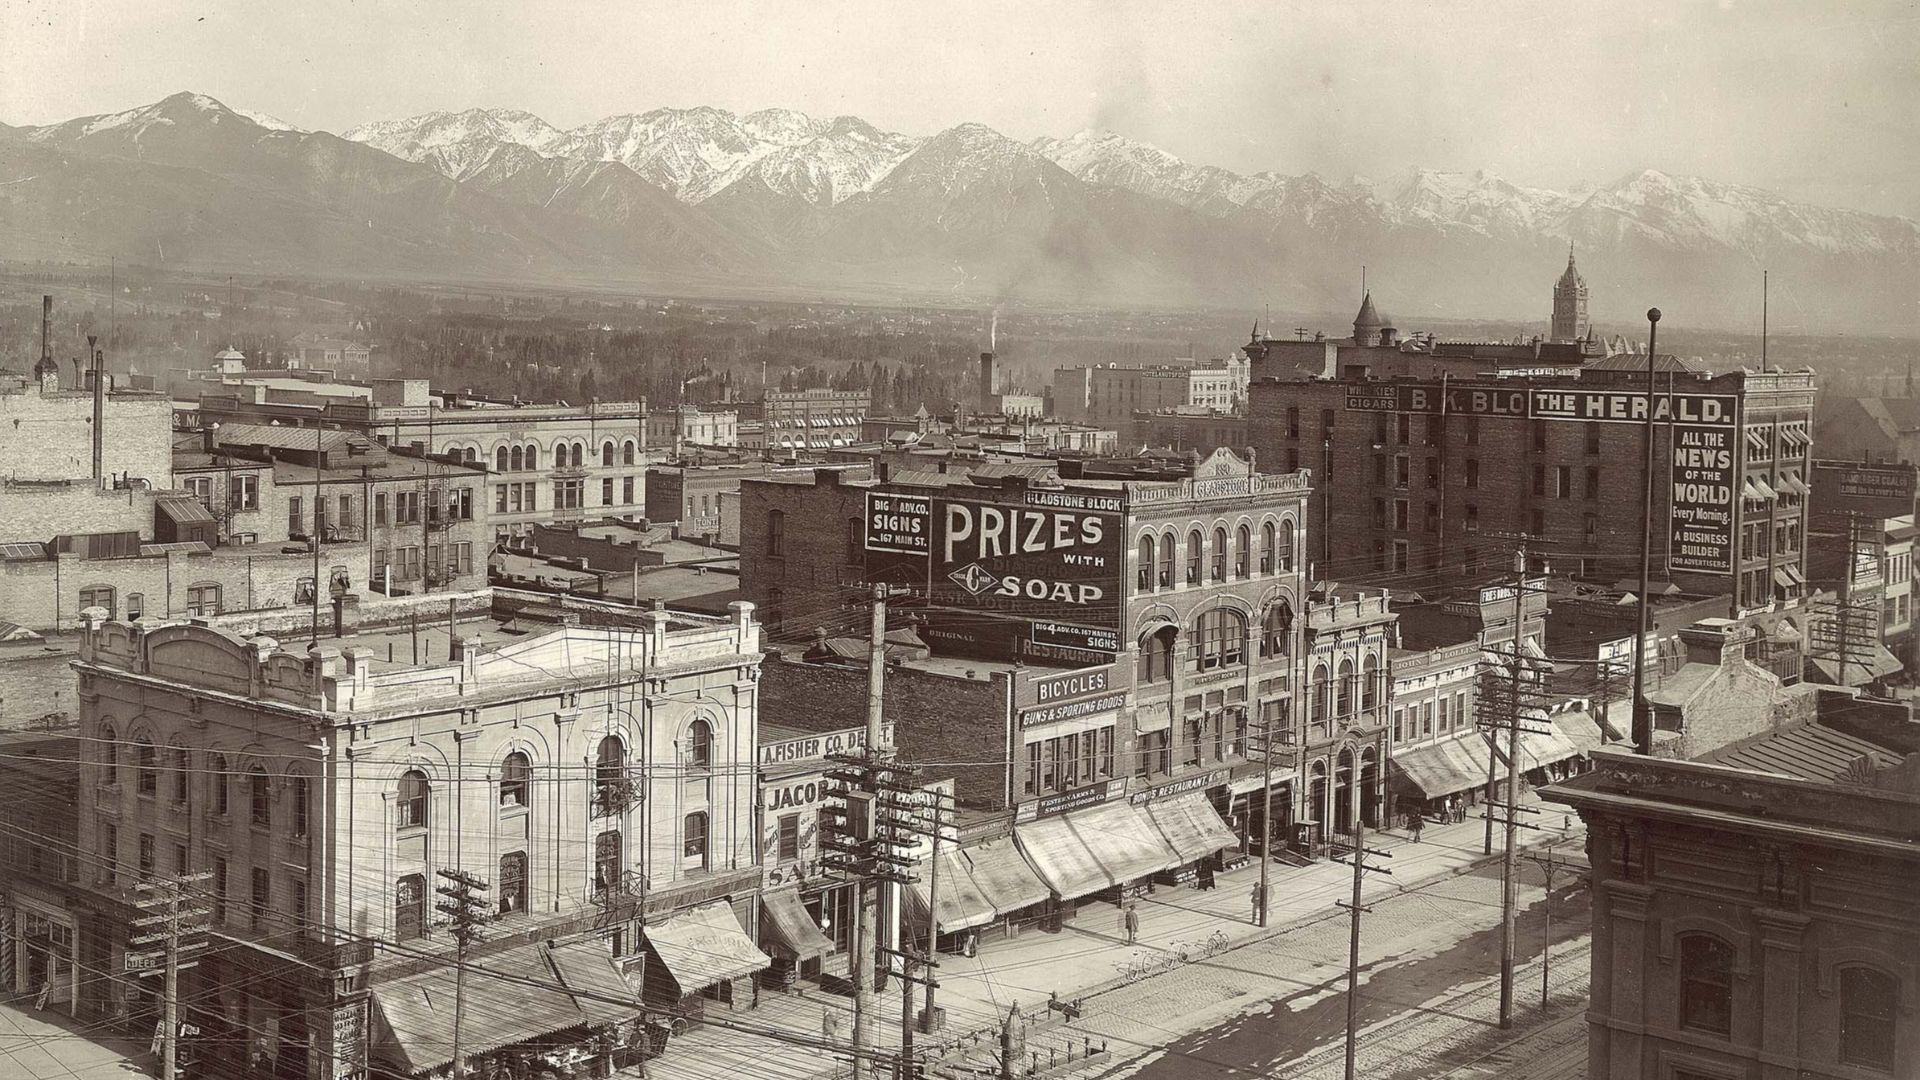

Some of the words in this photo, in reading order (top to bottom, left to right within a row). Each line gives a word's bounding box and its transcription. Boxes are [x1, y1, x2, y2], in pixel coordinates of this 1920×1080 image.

[1350, 399, 1395, 410] CIGARS
[1536, 394, 1576, 411] THE
[1586, 395, 1730, 423] HERALD.
[173, 413, 181, 426] &
[1681, 432, 1701, 446] ALL
[1704, 433, 1724, 447] THE
[1675, 448, 1731, 469] NEWS
[1685, 470, 1699, 480] OF
[1702, 471, 1721, 481] THE
[1674, 483, 1730, 505] WORLD
[875, 500, 889, 511] BIG
[1027, 493, 1085, 508] GLADSTONE
[1087, 498, 1121, 511] BLOCK
[1673, 506, 1695, 522] Every
[1696, 507, 1731, 525] Morning.
[873, 514, 921, 533] SIGNS
[881, 533, 892, 543] 167
[895, 535, 912, 545] MAIN
[914, 537, 927, 547] ST.
[944, 503, 1103, 563] PRIZES
[1674, 531, 1681, 541] A
[1683, 532, 1728, 545] BUSINESS
[1681, 545, 1720, 557] BUILDER
[1063, 553, 1104, 567] WITH
[1671, 557, 1683, 565] FOR
[1684, 558, 1730, 569] ADVERTISERS.
[995, 575, 1103, 605] SOAP
[1444, 604, 1478, 614] SIGNS
[929, 629, 976, 643] ORIGINAL
[1036, 623, 1047, 631] BIG
[1048, 624, 1056, 635] 4
[1092, 629, 1107, 638] MAIN
[1088, 637, 1117, 650] SIGNS
[1396, 660, 1423, 669] JOHN
[1040, 673, 1106, 700] BICYCLES.
[1023, 709, 1047, 726] GUNS
[1048, 709, 1056, 721] &
[1056, 700, 1096, 720] SPORTING
[1097, 694, 1124, 711] GOODS
[825, 735, 844, 752] CO.
[769, 779, 829, 811] JACOB
[1089, 788, 1096, 796] &
[1044, 801, 1075, 814] SPORTING
[1076, 796, 1095, 807] GOODS
